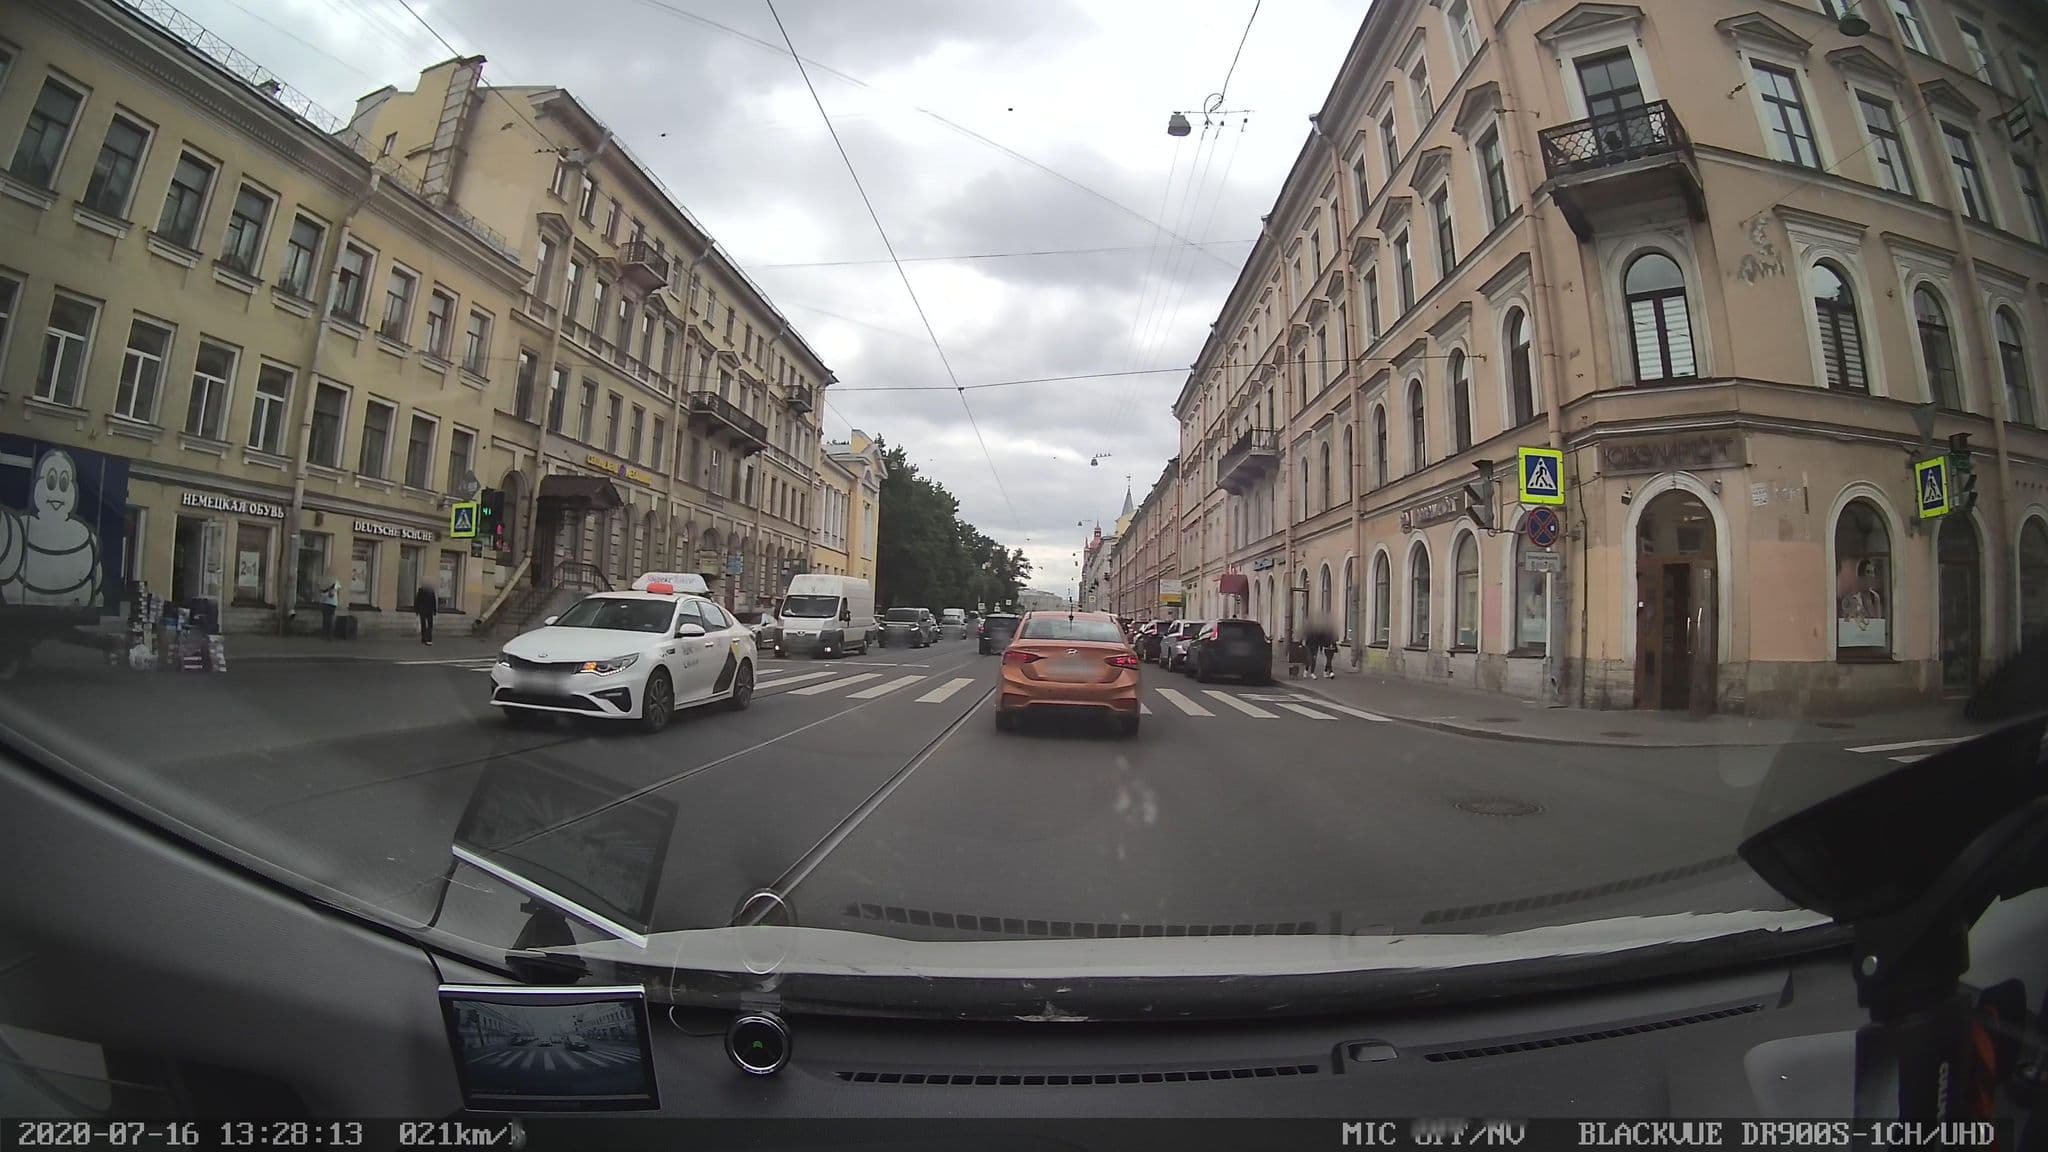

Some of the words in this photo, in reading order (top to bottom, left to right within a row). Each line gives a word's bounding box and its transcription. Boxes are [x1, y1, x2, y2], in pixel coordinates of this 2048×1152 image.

[183, 493, 246, 513] НЕМЕЦКАЯ
[249, 503, 284, 518] ОБУВЬ
[354, 521, 400, 537] DEUTSCHE
[401, 528, 433, 541] SCHUHE
